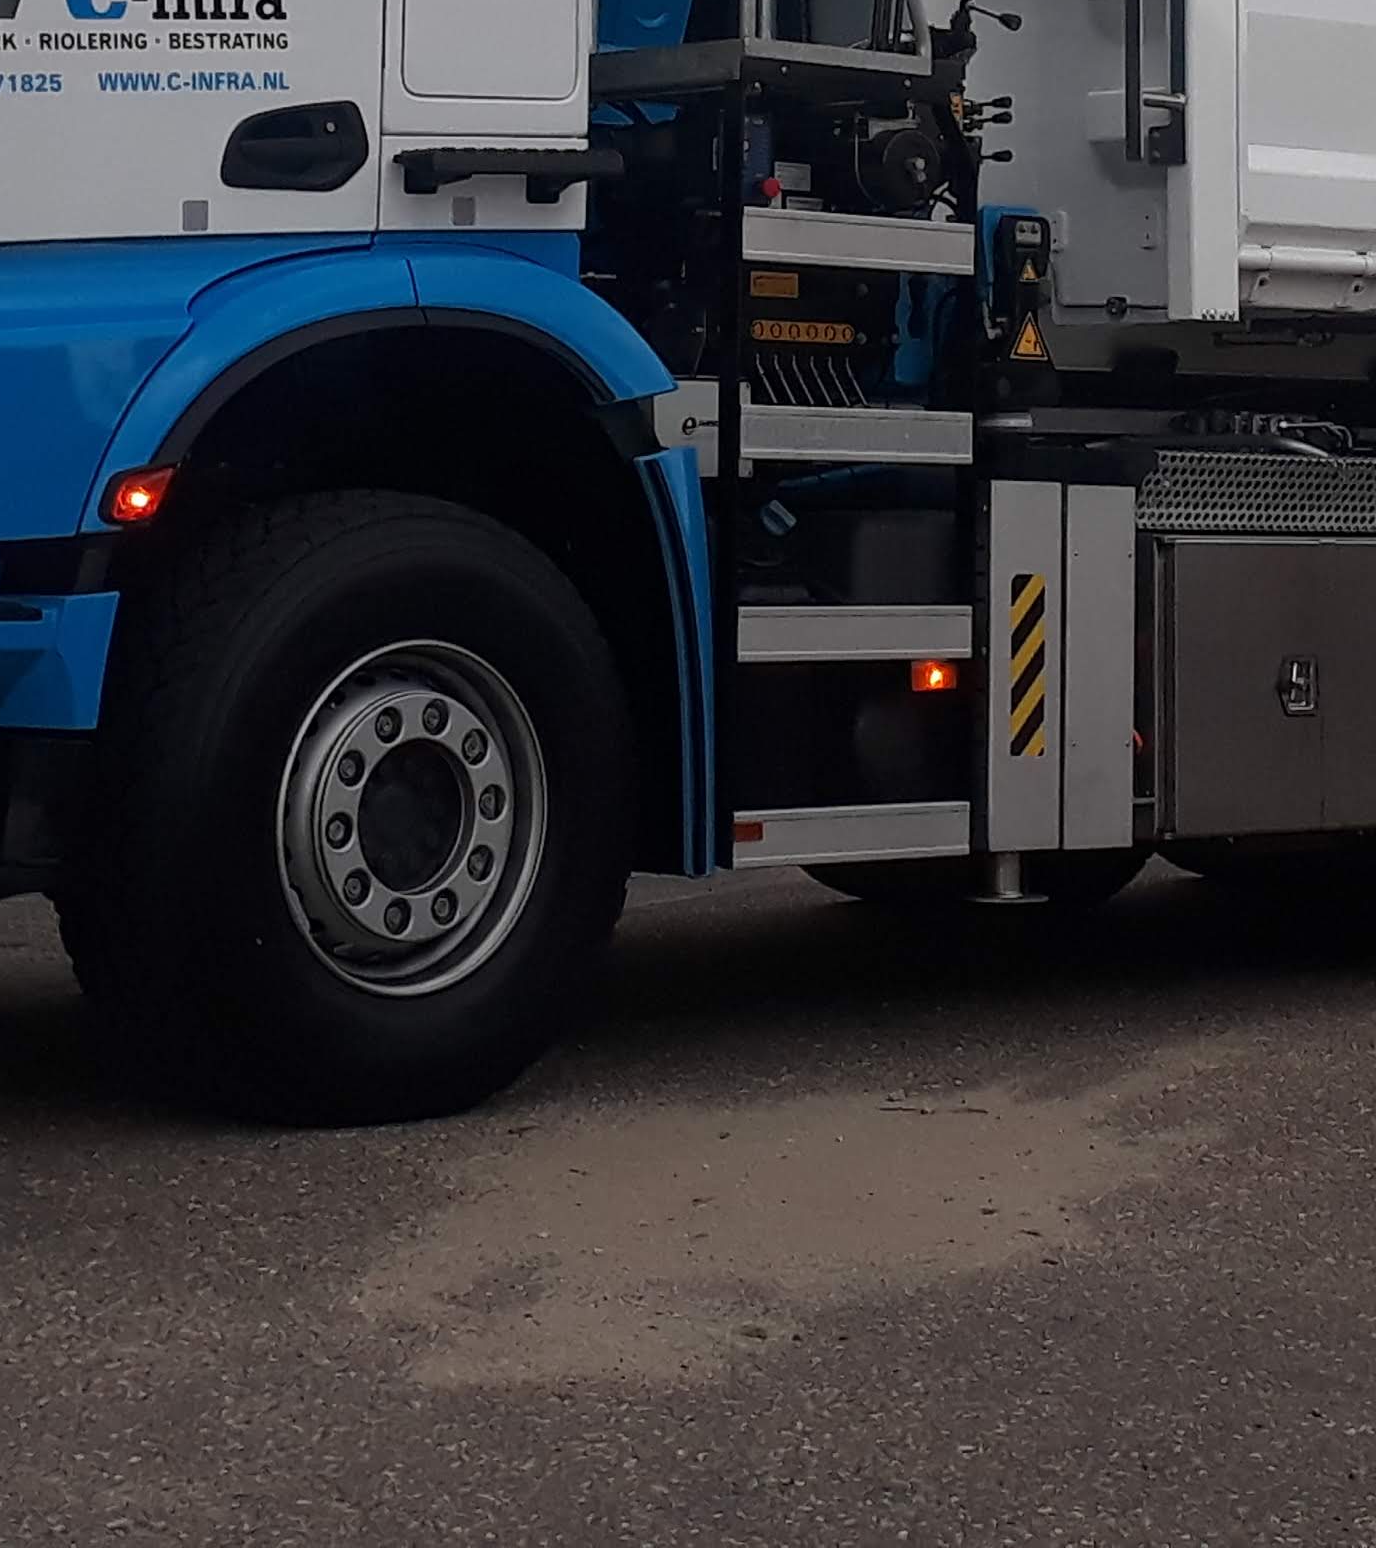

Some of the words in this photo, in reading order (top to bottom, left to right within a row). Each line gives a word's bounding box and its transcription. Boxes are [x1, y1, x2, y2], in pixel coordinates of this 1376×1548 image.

[39, 32, 148, 51] RIOLERING
[168, 31, 289, 51] BESTRATING
[98, 70, 290, 92] WWW.C-INFRA.NL
